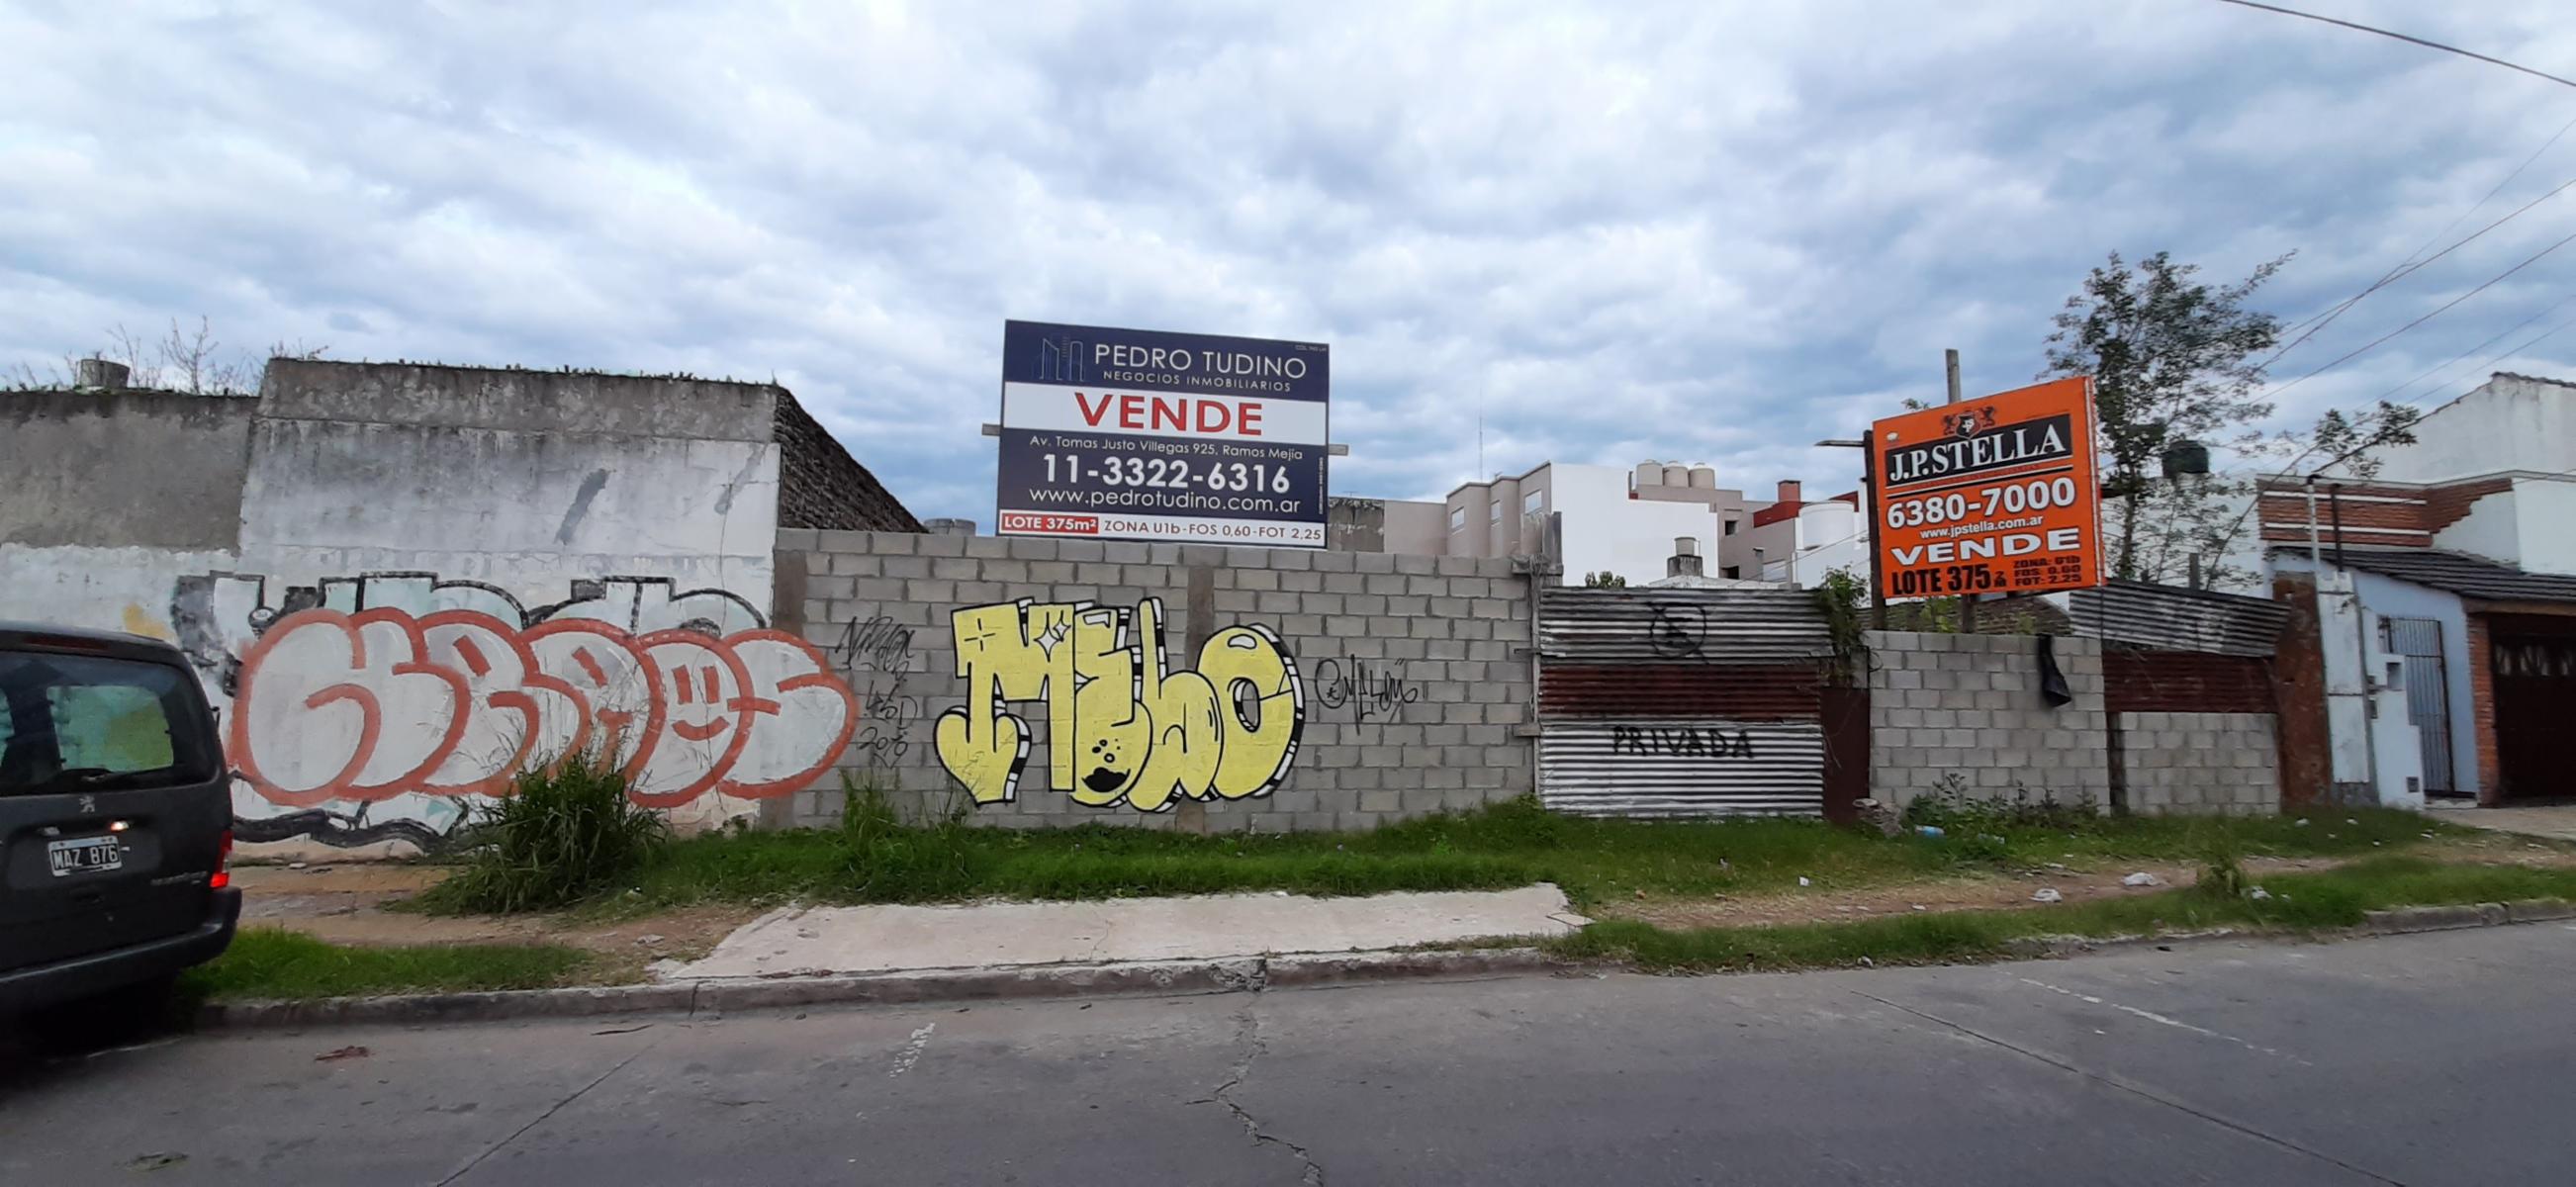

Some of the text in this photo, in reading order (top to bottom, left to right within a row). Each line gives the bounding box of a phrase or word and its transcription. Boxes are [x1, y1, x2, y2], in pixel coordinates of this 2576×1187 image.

[1095, 343, 1307, 380] PEDRO TUDINO
[1103, 370, 1291, 393] NEGOCIOS INMOBILIARIOS
[1074, 392, 1262, 436] VENDE
[1030, 435, 1052, 446] Av.
[1056, 436, 1098, 449] Tomas
[1102, 438, 1136, 451] Justo
[1140, 440, 1189, 455] Villegas
[1223, 444, 1265, 458] Ramos
[1890, 423, 2067, 482] J.P.STELLA
[1044, 453, 1290, 494] 11-3322-6316
[1029, 489, 1301, 513] www.pedrotudino.com.ar
[1886, 477, 2076, 529] 6380-7000
[1004, 515, 1042, 528] LOTE
[1104, 520, 1149, 532] ZONA
[1920, 515, 2043, 539] www.jpstella.com.ar
[1890, 528, 2080, 566] VENDE
[1891, 568, 1942, 594] LOTE
[1947, 564, 1991, 592] 375
[1613, 726, 1753, 758] PRIVADA
[52, 845, 118, 868] MAZ 876
